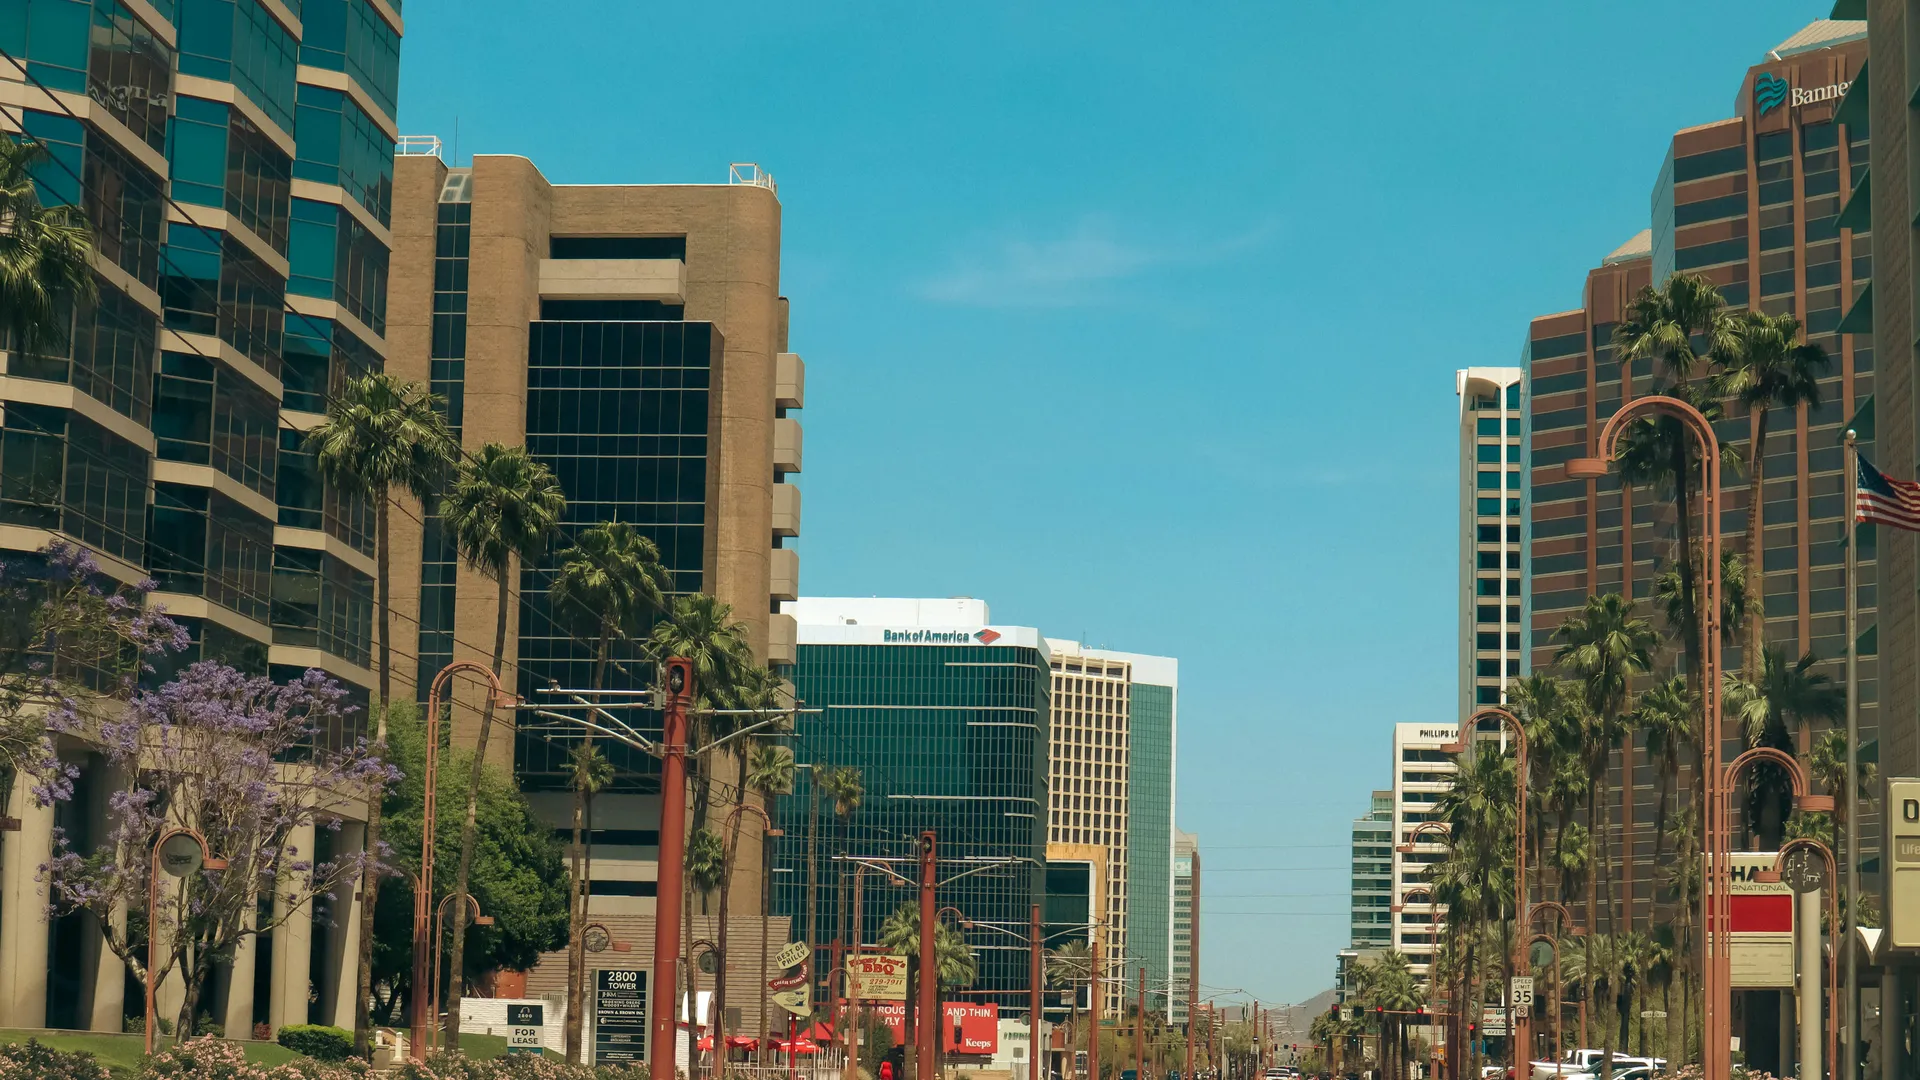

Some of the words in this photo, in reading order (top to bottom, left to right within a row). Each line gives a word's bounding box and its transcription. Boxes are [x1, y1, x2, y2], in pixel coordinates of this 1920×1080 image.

[884, 629, 911, 643] Bank
[924, 629, 969, 643] America
[1420, 730, 1449, 738] PHILLIPS
[777, 948, 794, 962] BEST
[795, 943, 804, 952] OF
[782, 950, 806, 967] PHILLY
[863, 964, 894, 976] BBQ
[608, 971, 637, 981] 2800
[608, 982, 637, 990] TOWER
[1513, 991, 1531, 1003] 35
[947, 1007, 966, 1017] AND
[969, 1008, 994, 1018] THIN.
[965, 1038, 992, 1049] Keeps
